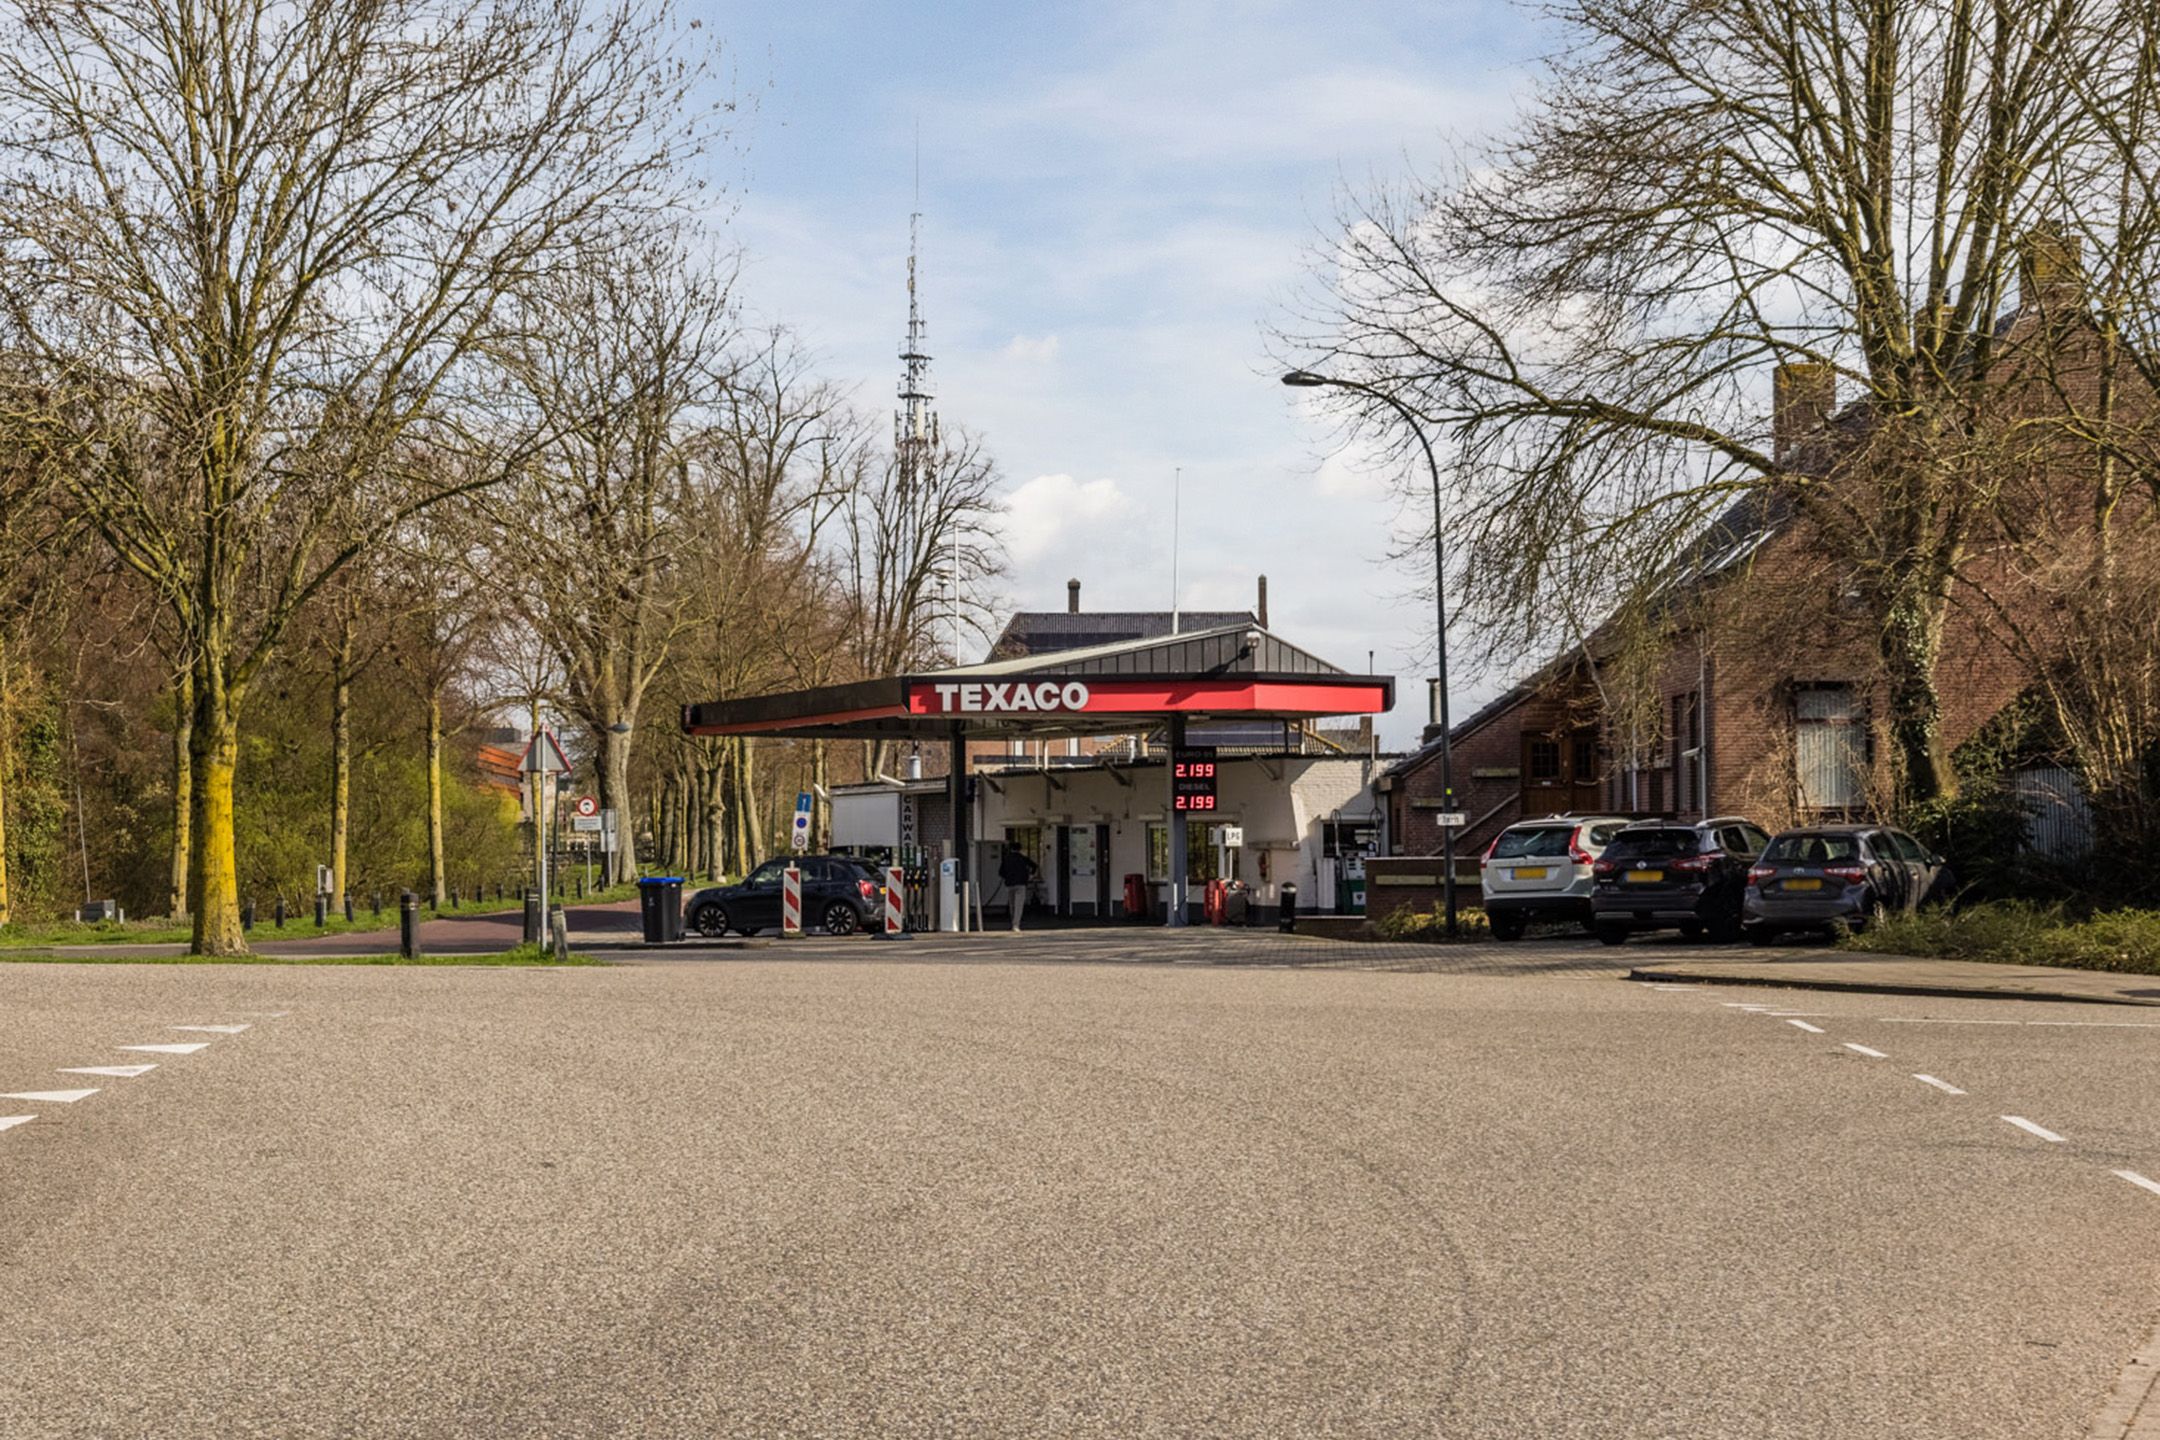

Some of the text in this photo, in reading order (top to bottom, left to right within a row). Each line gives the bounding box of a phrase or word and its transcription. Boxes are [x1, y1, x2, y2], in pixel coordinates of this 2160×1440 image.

[935, 682, 1089, 712] TEXACO
[1178, 783, 1211, 791] DIESEL
[1227, 831, 1241, 841] LPG
